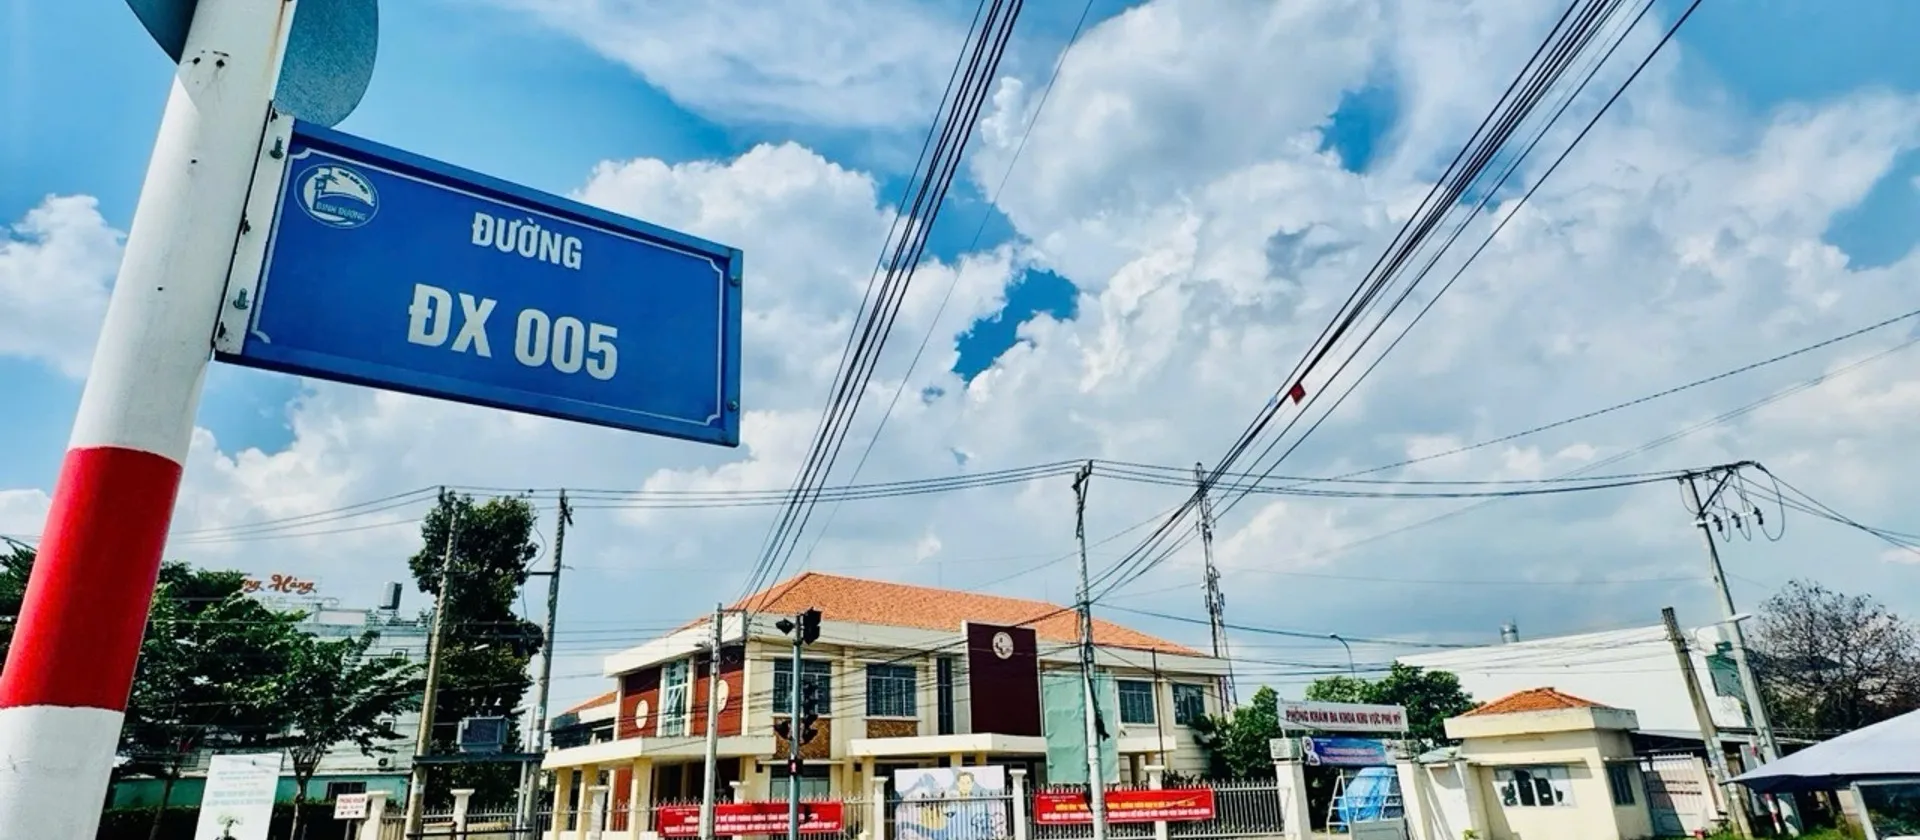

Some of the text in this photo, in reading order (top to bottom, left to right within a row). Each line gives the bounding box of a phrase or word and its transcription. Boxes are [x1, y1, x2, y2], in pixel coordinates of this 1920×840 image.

[472, 212, 583, 270] ĐƯỜNG
[407, 283, 619, 381] ĐX 005
